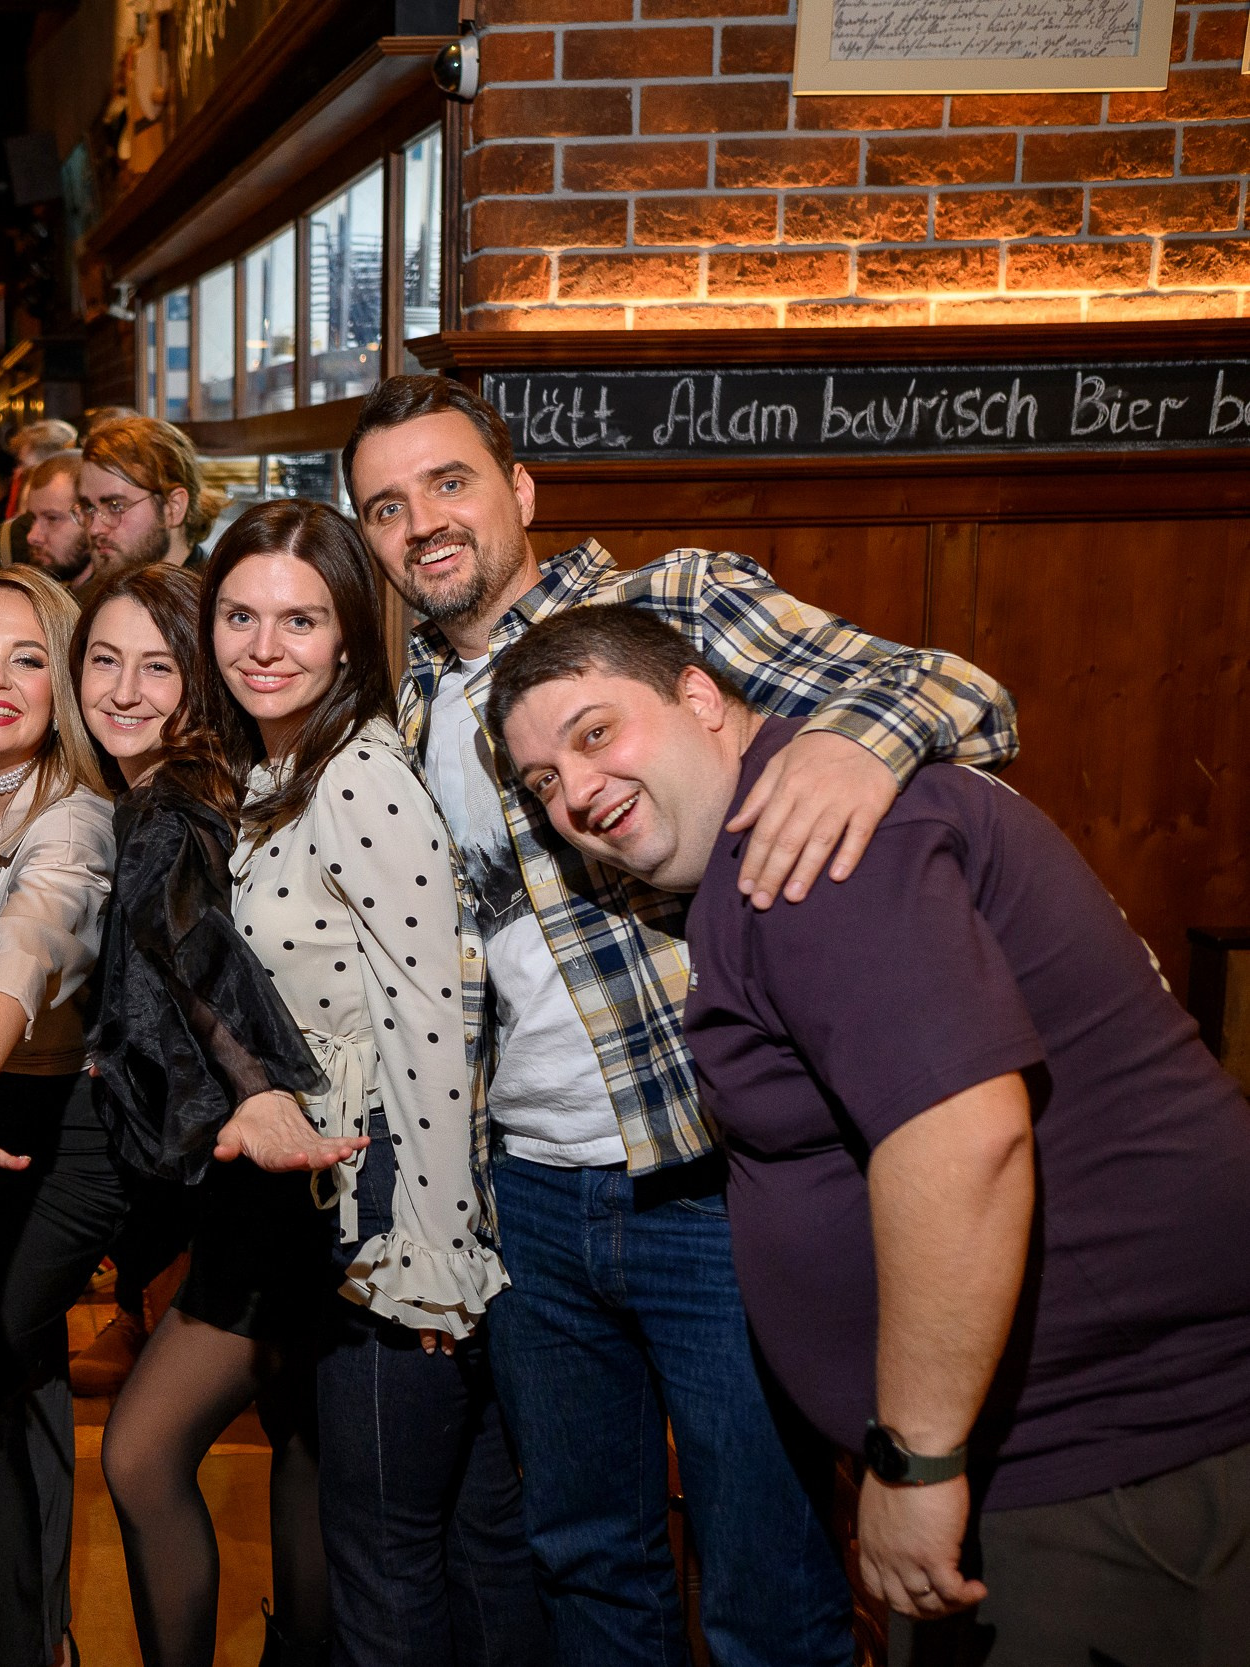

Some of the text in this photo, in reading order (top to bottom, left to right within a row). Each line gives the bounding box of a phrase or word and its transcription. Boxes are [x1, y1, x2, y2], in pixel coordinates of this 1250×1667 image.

[499, 378, 632, 448] Hätt
[652, 374, 798, 445] Adam
[1070, 371, 1189, 438] Bier
